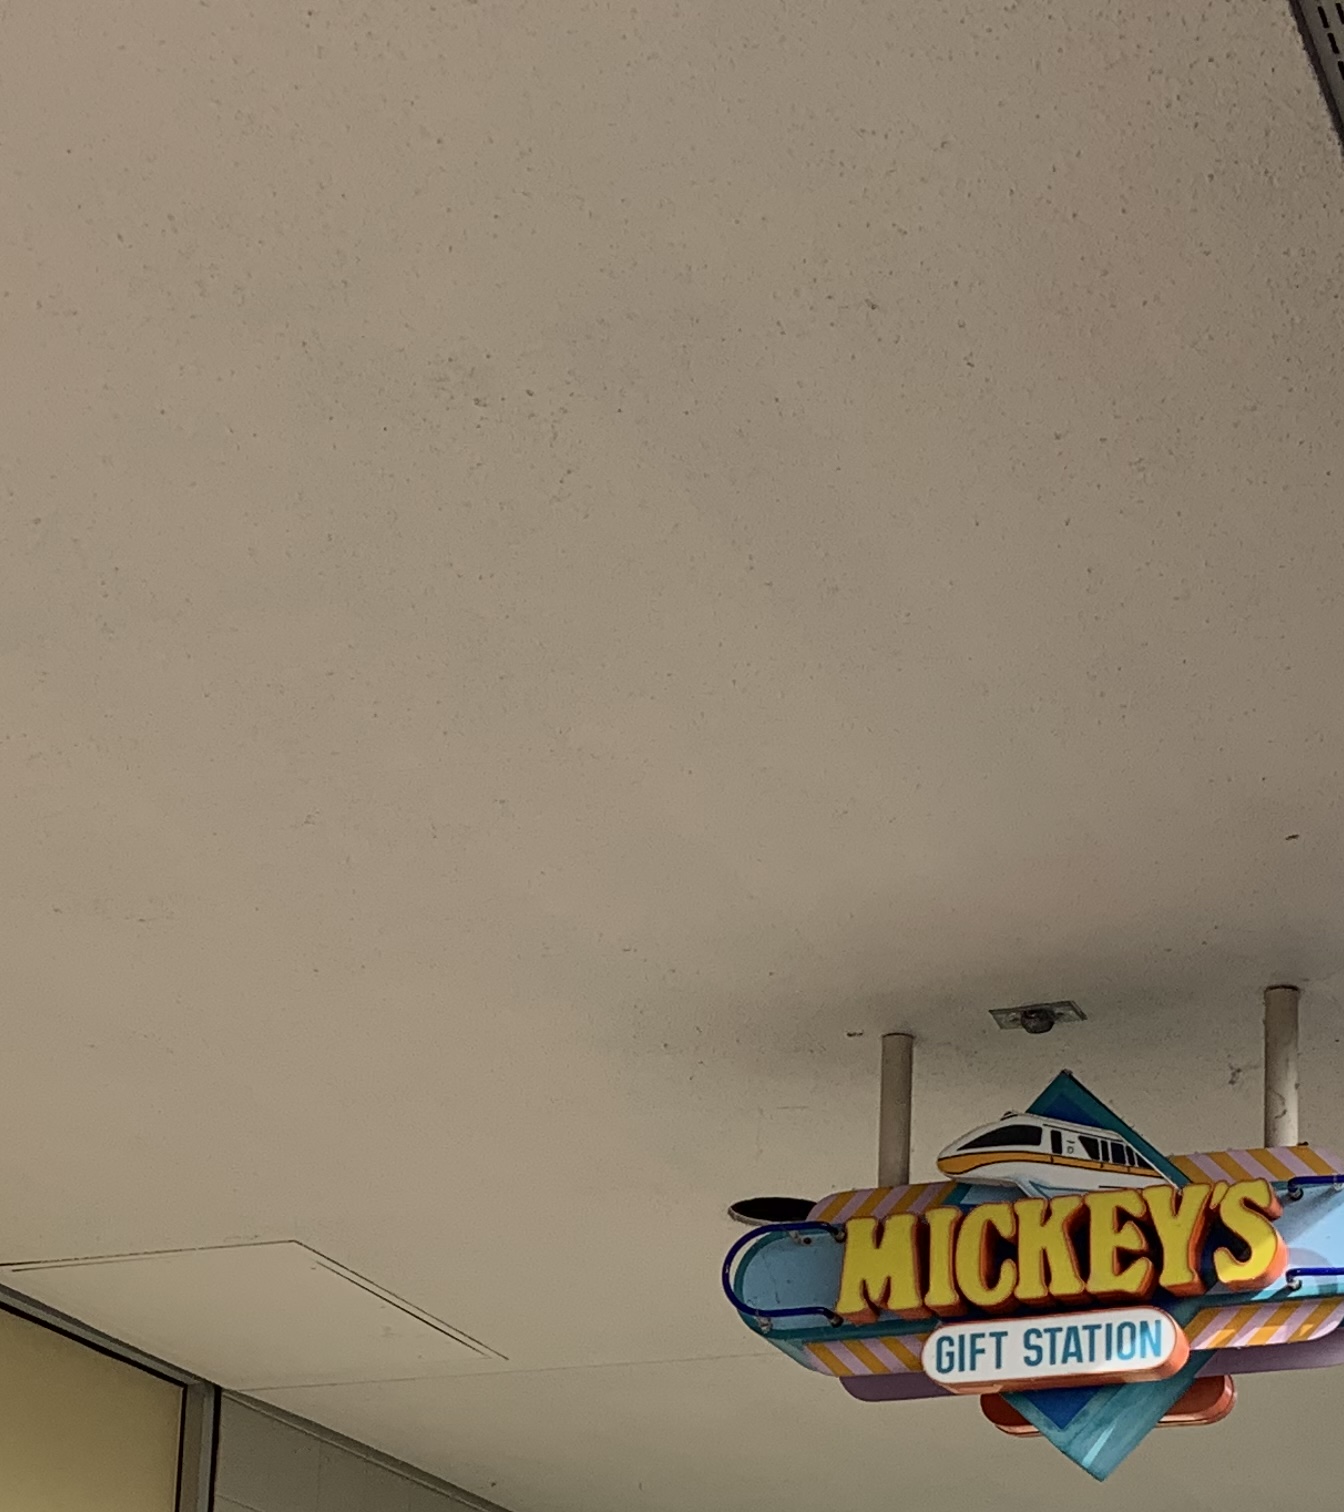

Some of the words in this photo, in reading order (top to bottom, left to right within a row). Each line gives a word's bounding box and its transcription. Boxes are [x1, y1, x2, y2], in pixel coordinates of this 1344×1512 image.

[836, 1178, 1286, 1320] MICKEY'S
[934, 1329, 1006, 1375] GIFT
[1022, 1318, 1163, 1367] STATION
